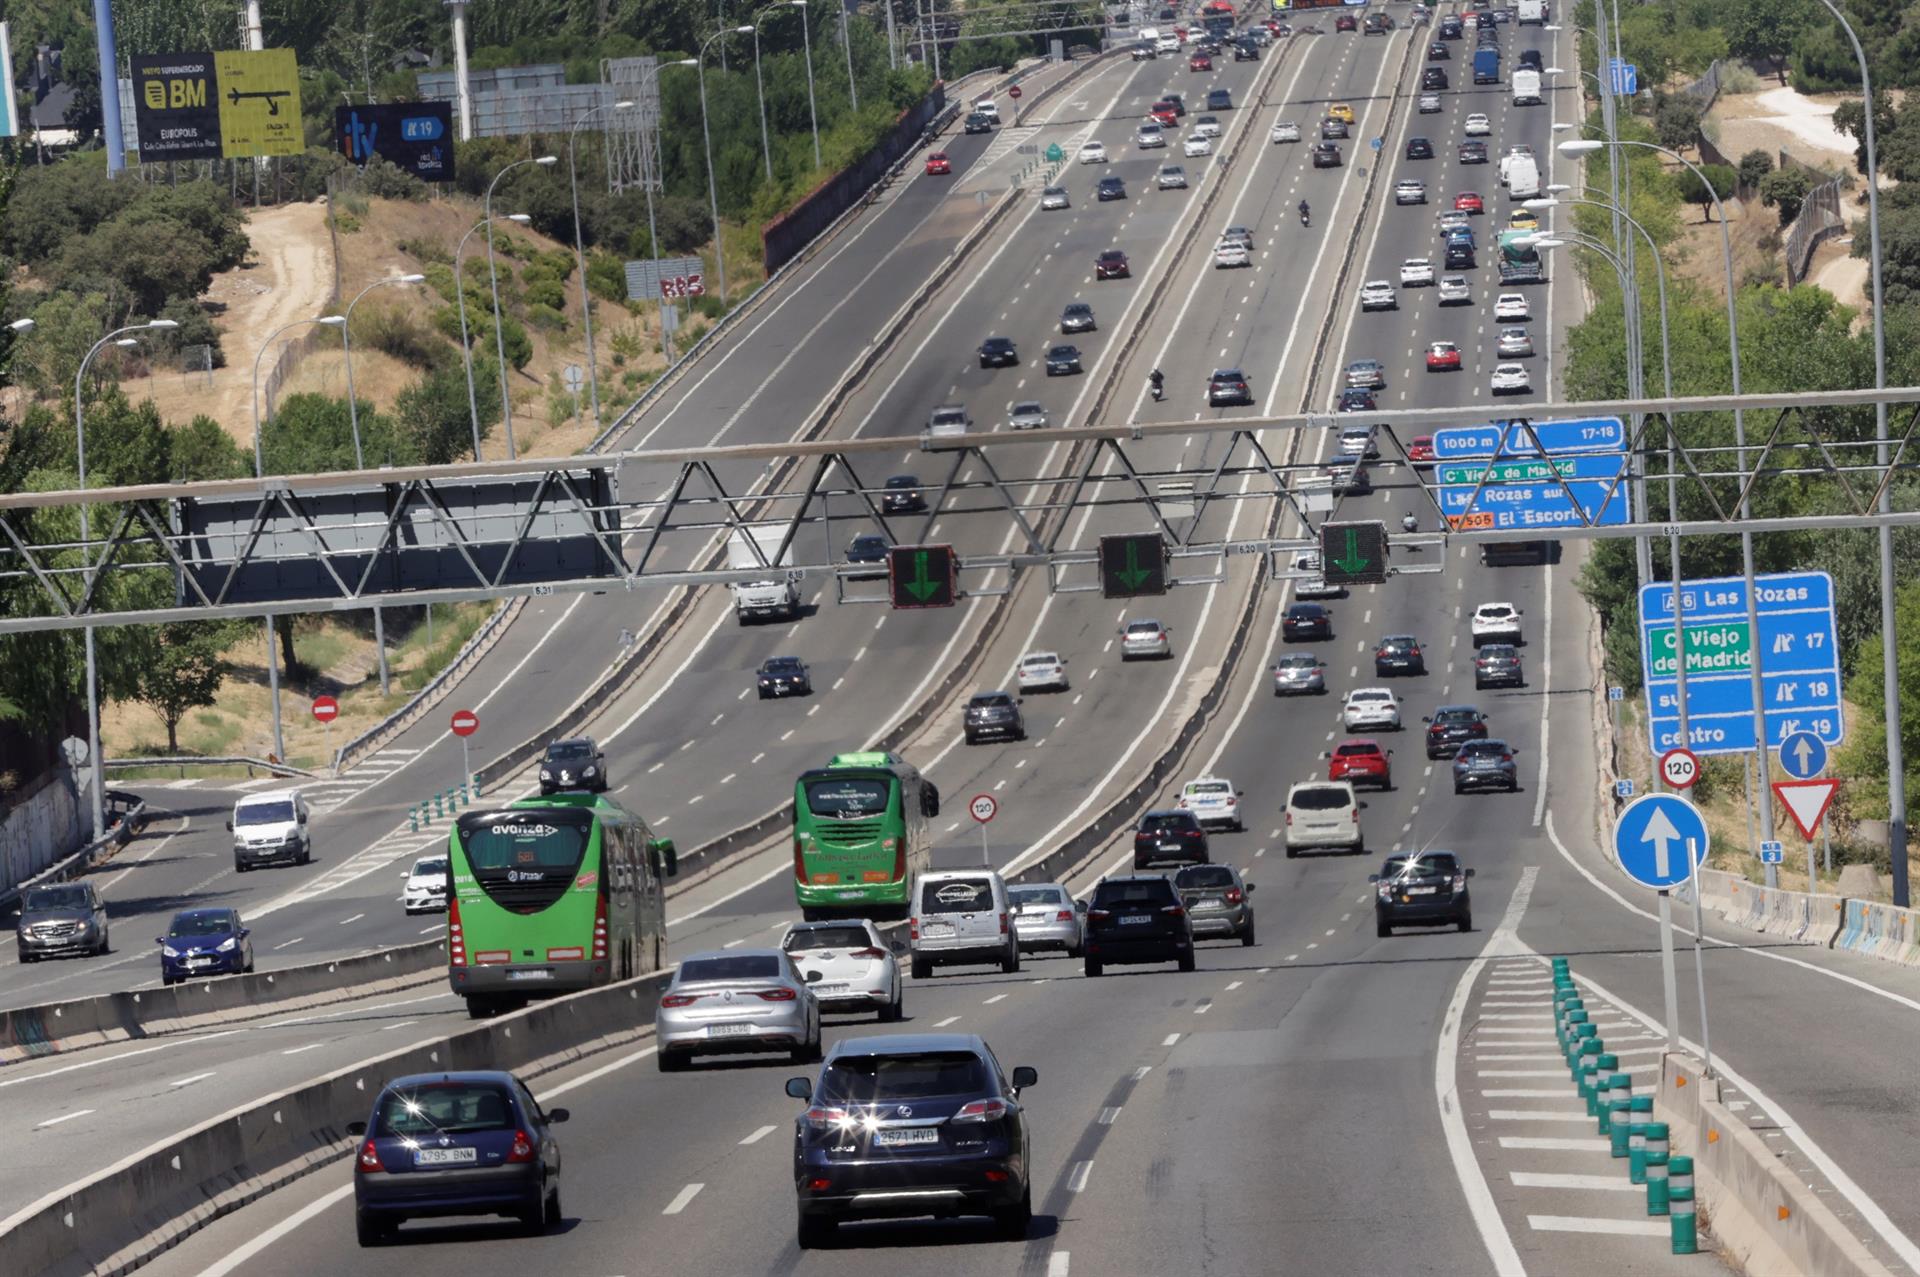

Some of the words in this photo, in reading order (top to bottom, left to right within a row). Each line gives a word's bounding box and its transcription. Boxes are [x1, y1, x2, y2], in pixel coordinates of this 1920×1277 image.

[170, 79, 206, 108] BM
[420, 121, 433, 136] 19
[1581, 426, 1615, 440] 17-18
[1443, 437, 1477, 449] 1000
[1481, 437, 1493, 447] m
[1464, 469, 1498, 482] Vieo
[1504, 467, 1521, 479] de
[1485, 488, 1533, 503] Rozas
[1543, 488, 1564, 499] sur
[1450, 514, 1492, 526] M505
[1499, 511, 1515, 526] El
[1665, 594, 1693, 609] A6
[1704, 590, 1739, 607] Las
[1754, 587, 1809, 603] Rozas
[1690, 628, 1740, 648] Viejo
[1806, 632, 1825, 648] 17
[1654, 656, 1678, 671] de
[1686, 650, 1752, 669] Madrid
[1808, 682, 1829, 697] 18
[1659, 693, 1692, 708] su
[1812, 719, 1831, 735] 19
[1661, 726, 1725, 746] centro
[1667, 762, 1693, 775] 120
[975, 803, 991, 813] 120
[492, 823, 544, 835] avanza
[880, 1131, 908, 1144] 2671
[420, 1149, 448, 1161] 4795
[453, 1148, 474, 1159] BNM
